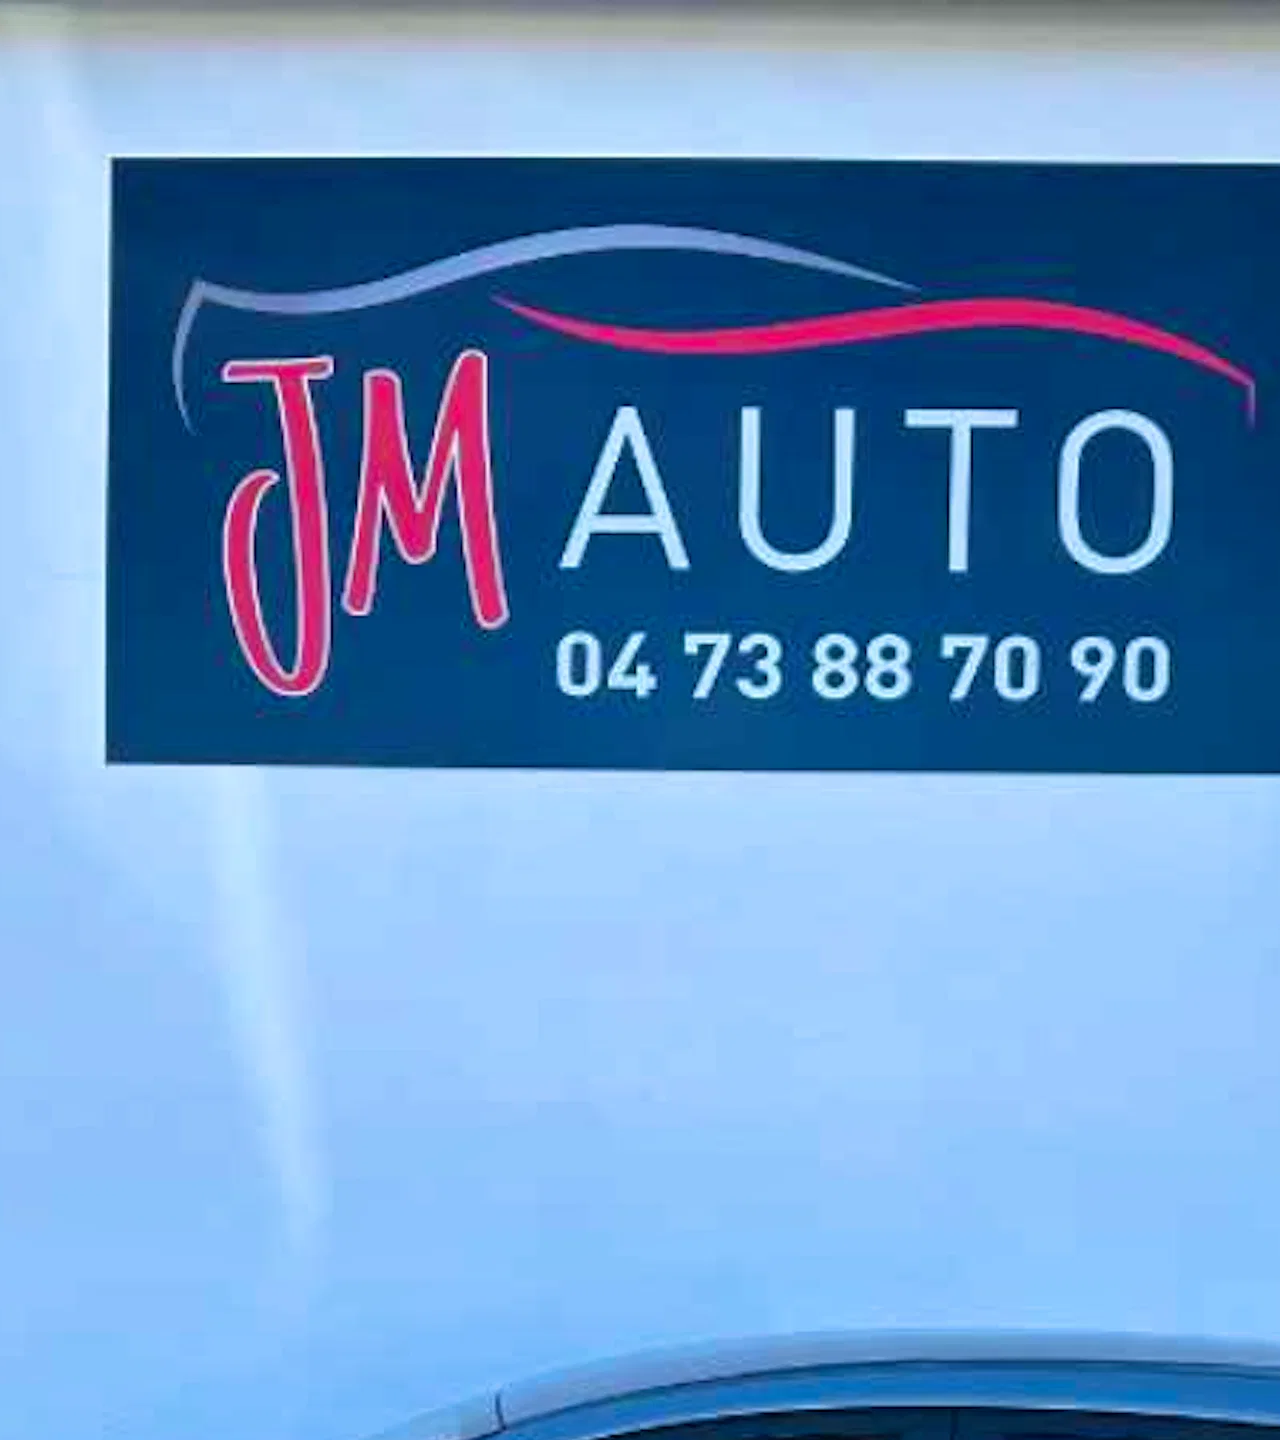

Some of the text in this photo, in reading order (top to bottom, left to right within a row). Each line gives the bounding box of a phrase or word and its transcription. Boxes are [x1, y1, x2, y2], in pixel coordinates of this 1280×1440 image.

[222, 349, 1171, 696] JM AUTO
[558, 633, 1168, 700] 04 73 88 70 90
